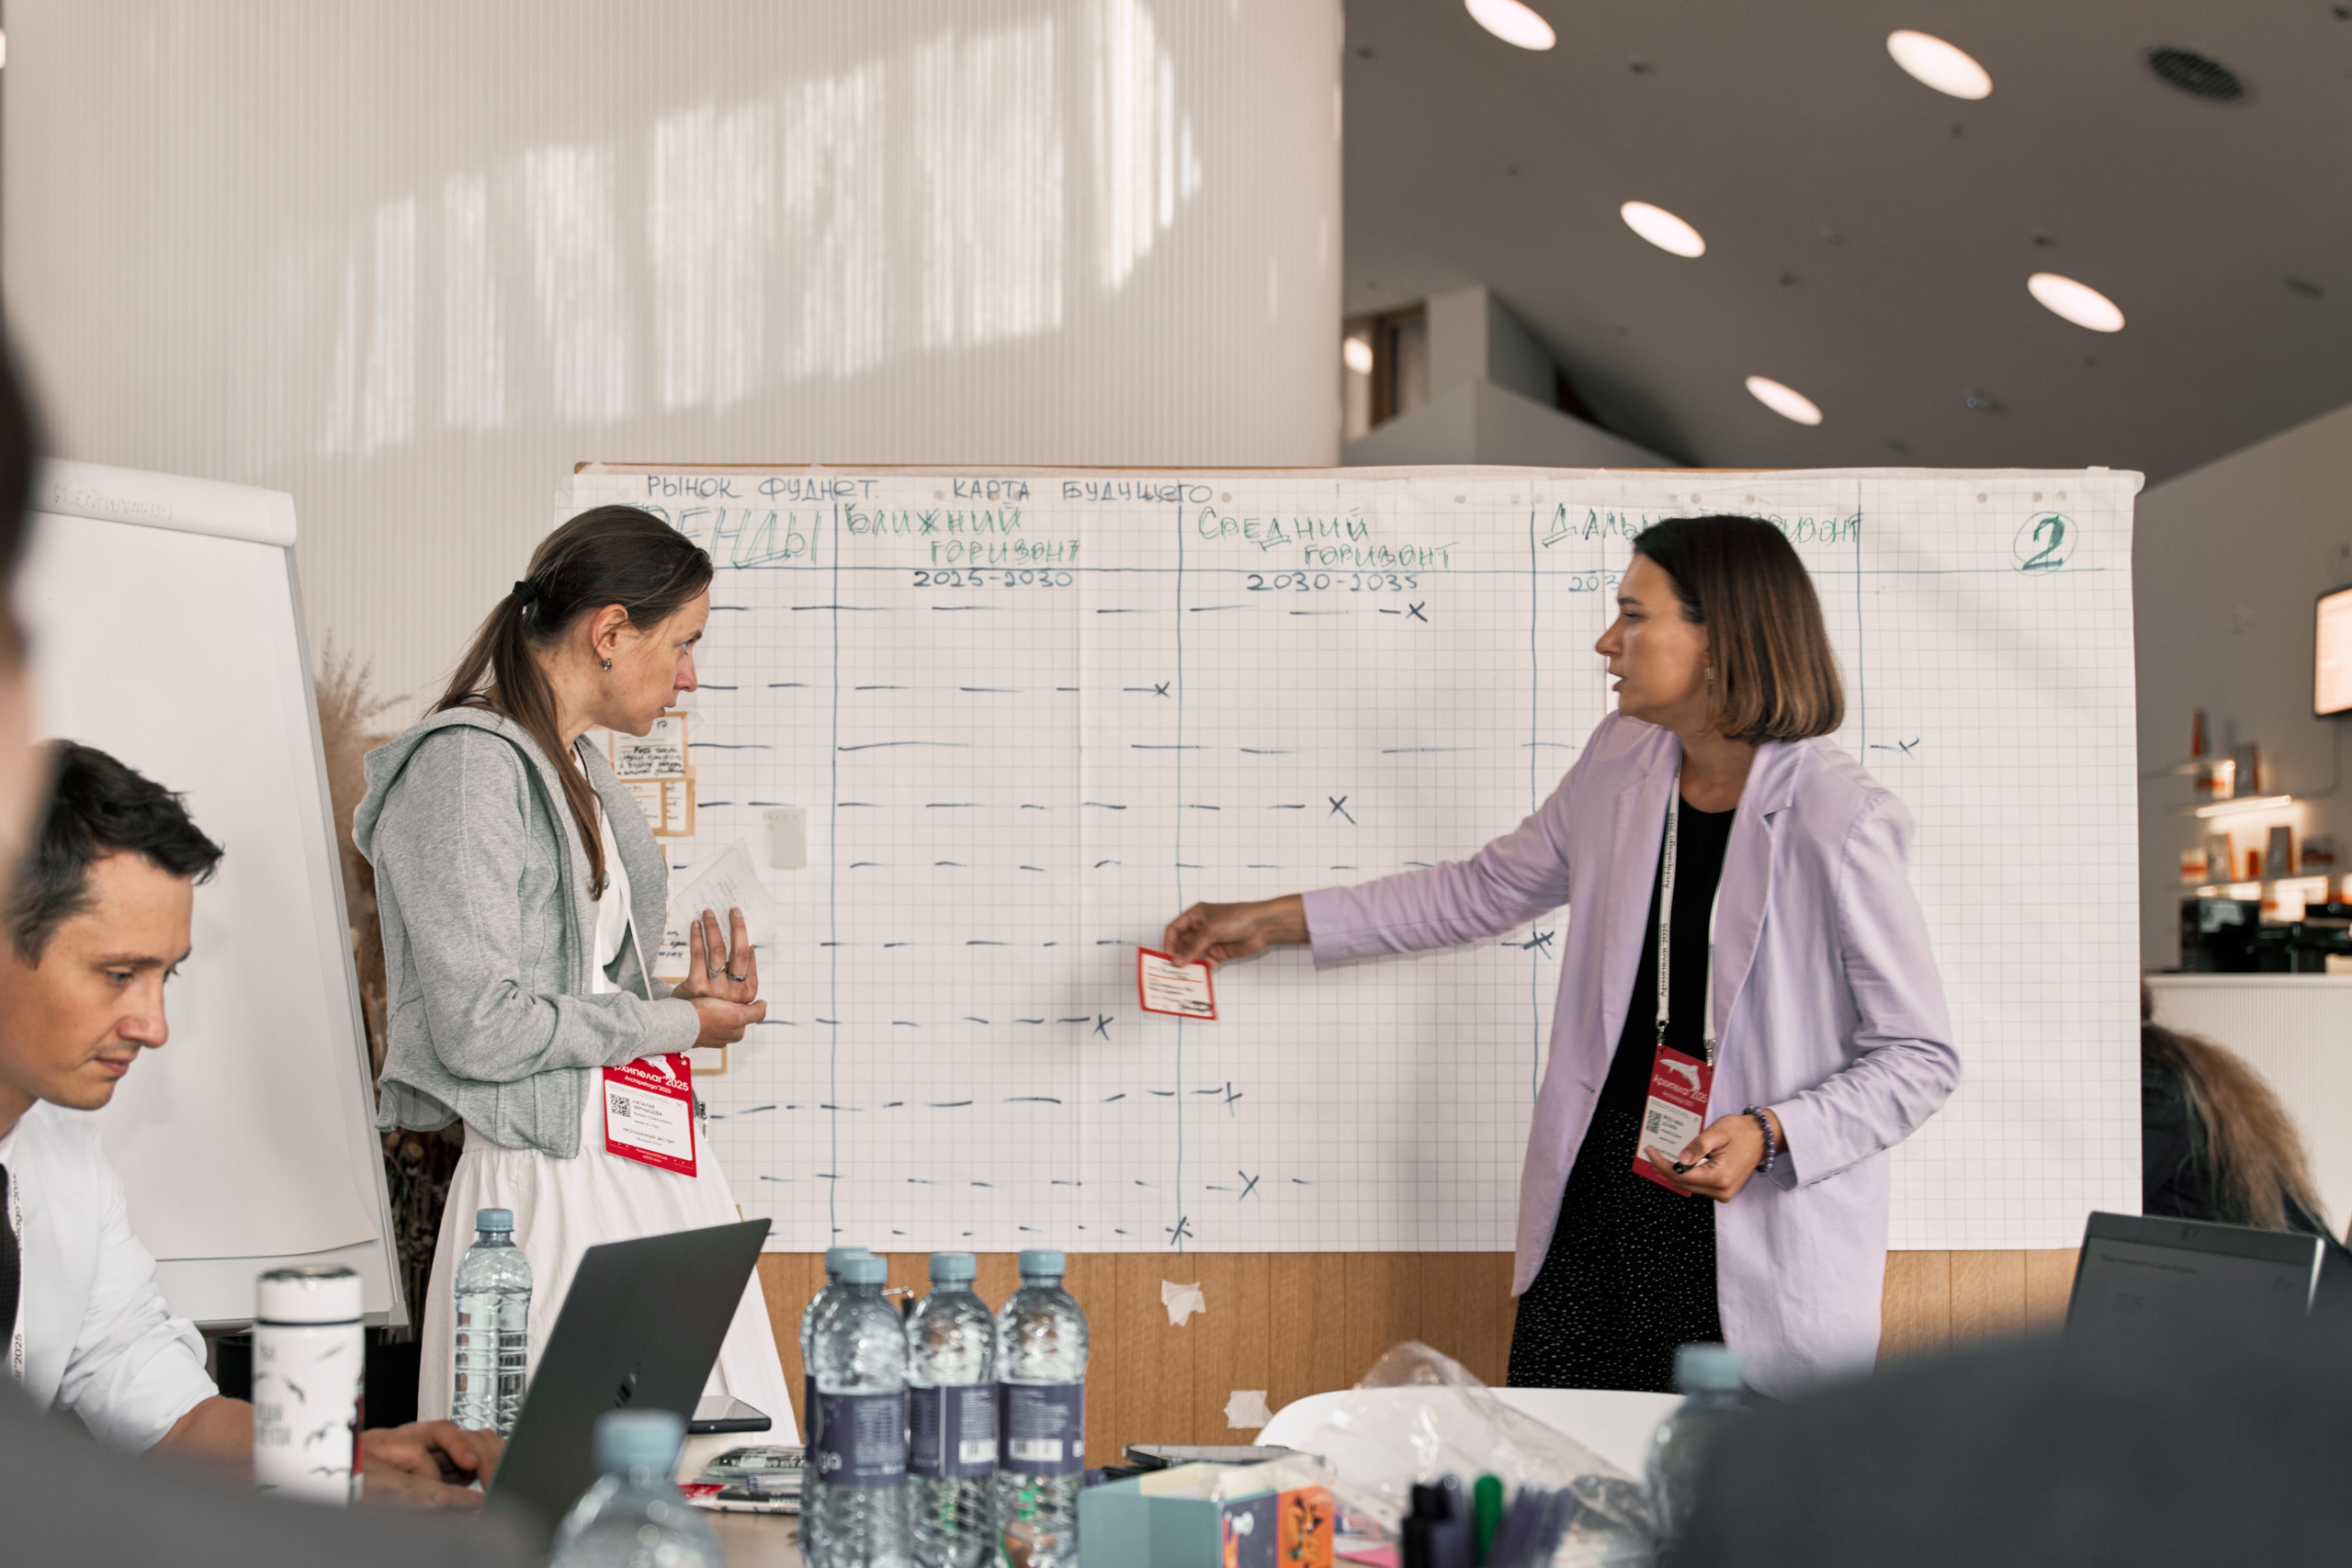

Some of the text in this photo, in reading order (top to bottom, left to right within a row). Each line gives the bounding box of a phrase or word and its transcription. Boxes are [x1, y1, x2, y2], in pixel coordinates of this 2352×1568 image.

[647, 475, 741, 498] РЫНОК
[954, 478, 1031, 501] КАРТА
[844, 502, 1022, 536] БЛИЖНИЙ
[1198, 506, 1370, 551] СРЕДНИЙ
[931, 538, 1080, 567] ГОРИЗОНТ
[1305, 540, 1460, 570] ГОРИЗОНТ
[912, 570, 1073, 588] 2025-2030
[1247, 572, 1418, 592] 2030-2035
[1567, 574, 1621, 592] 203
